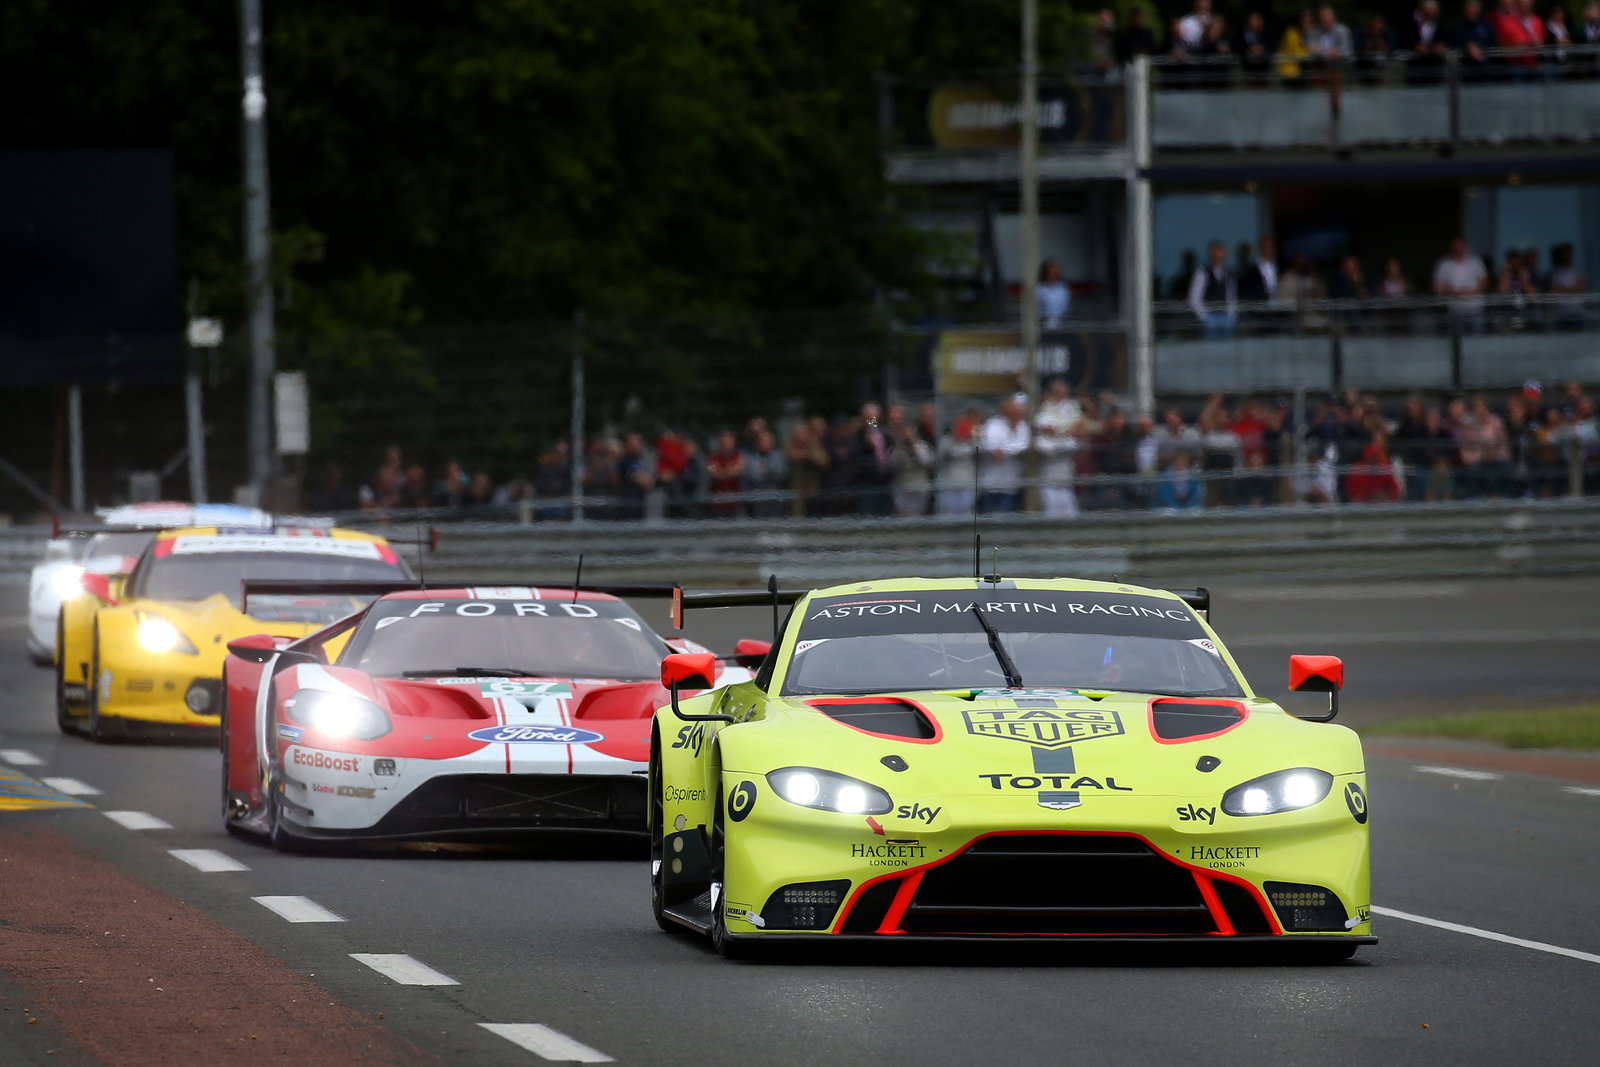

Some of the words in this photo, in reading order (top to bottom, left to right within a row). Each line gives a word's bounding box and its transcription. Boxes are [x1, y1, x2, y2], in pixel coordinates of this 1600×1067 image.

[409, 602, 598, 618] FORD
[811, 603, 921, 620] ASTON
[933, 602, 1057, 614] MARTIN
[1068, 603, 1191, 622] RACING
[489, 681, 558, 693] 67
[977, 710, 1104, 720] TAG
[494, 726, 577, 741] Ford
[979, 722, 1112, 741] HEUER
[293, 748, 360, 773] EcoBoost
[978, 773, 1133, 791] TOTAL
[896, 803, 942, 824] sky
[1176, 803, 1217, 825] sky
[851, 843, 927, 858] HACKETT
[1190, 846, 1262, 860] HACKETT
[1209, 861, 1245, 869] LONDON
